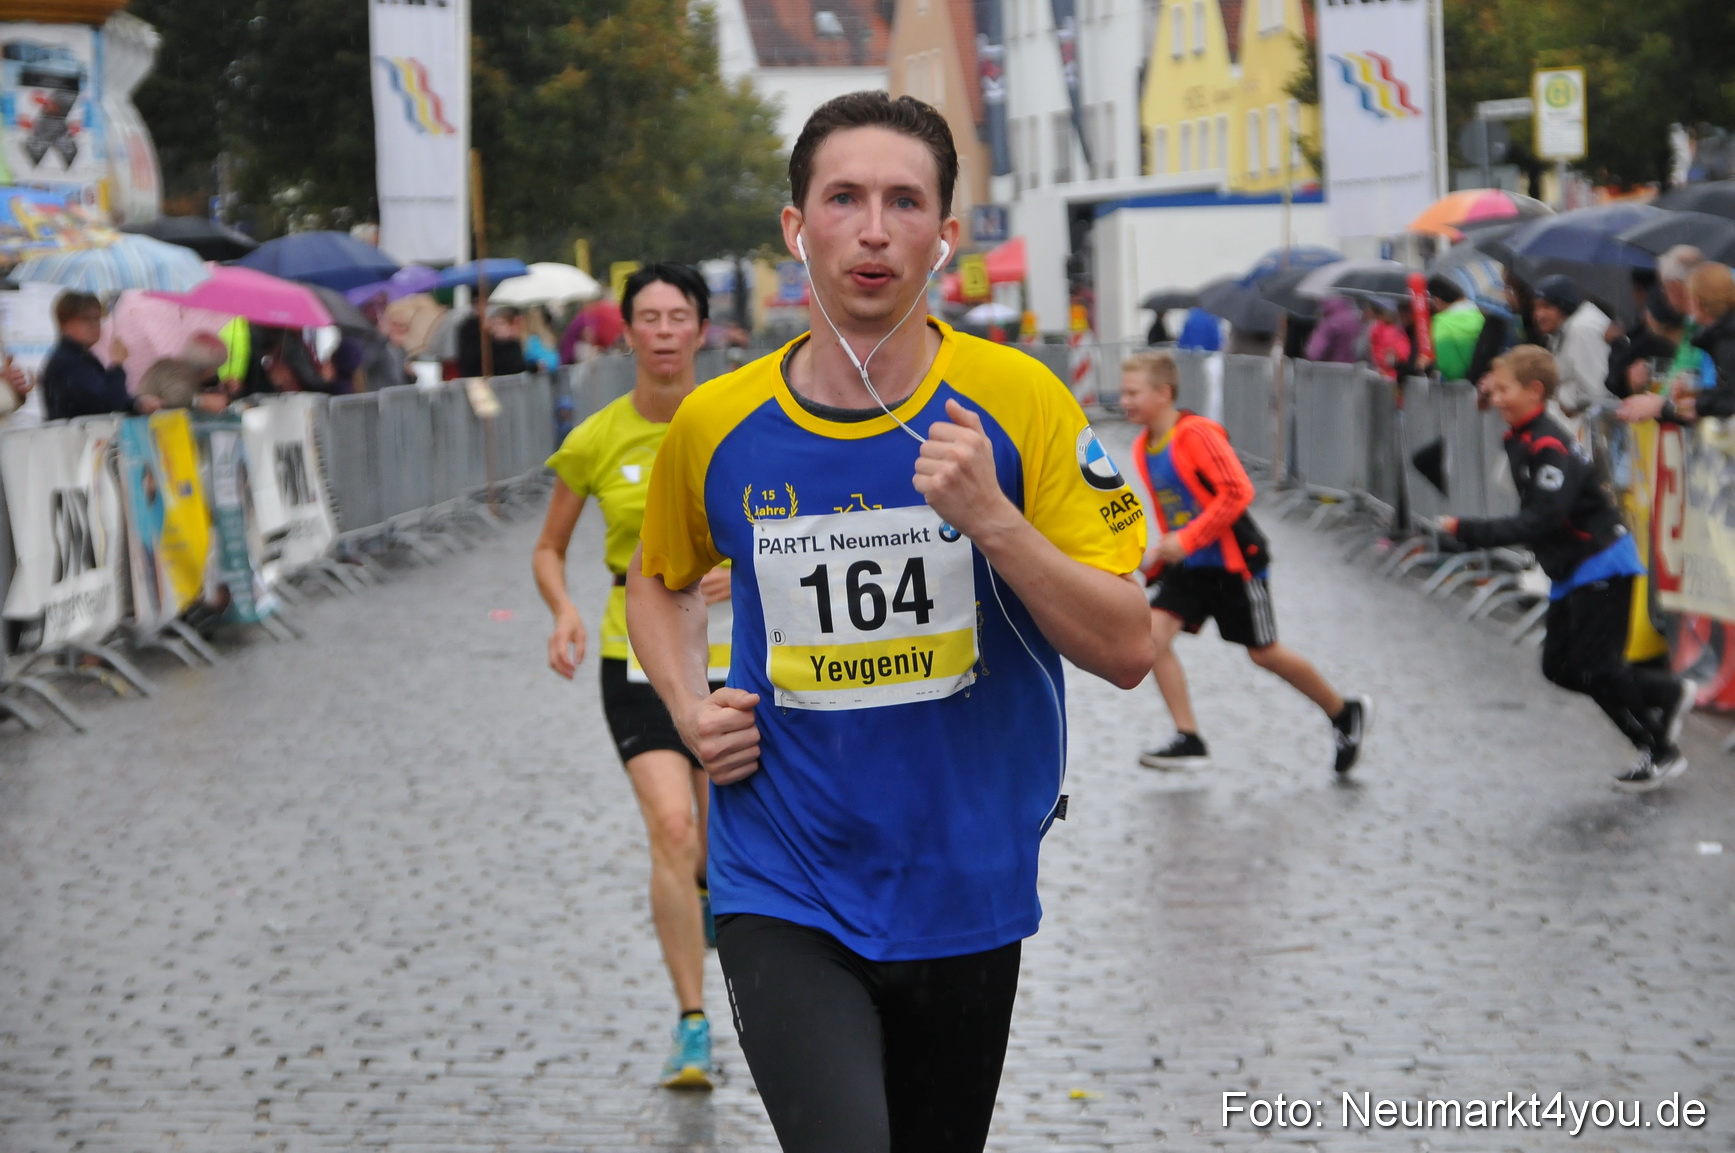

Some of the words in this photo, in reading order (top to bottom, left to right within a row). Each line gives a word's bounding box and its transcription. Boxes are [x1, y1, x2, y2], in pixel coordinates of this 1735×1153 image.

[761, 489, 776, 501] 15
[1099, 492, 1139, 524] PAR
[754, 505, 786, 516] Jahre
[758, 535, 825, 555] PARTL
[829, 527, 931, 551] Neumarkt
[799, 556, 934, 634] 164
[773, 631, 782, 643] D
[809, 646, 934, 685] Yevgeniy
